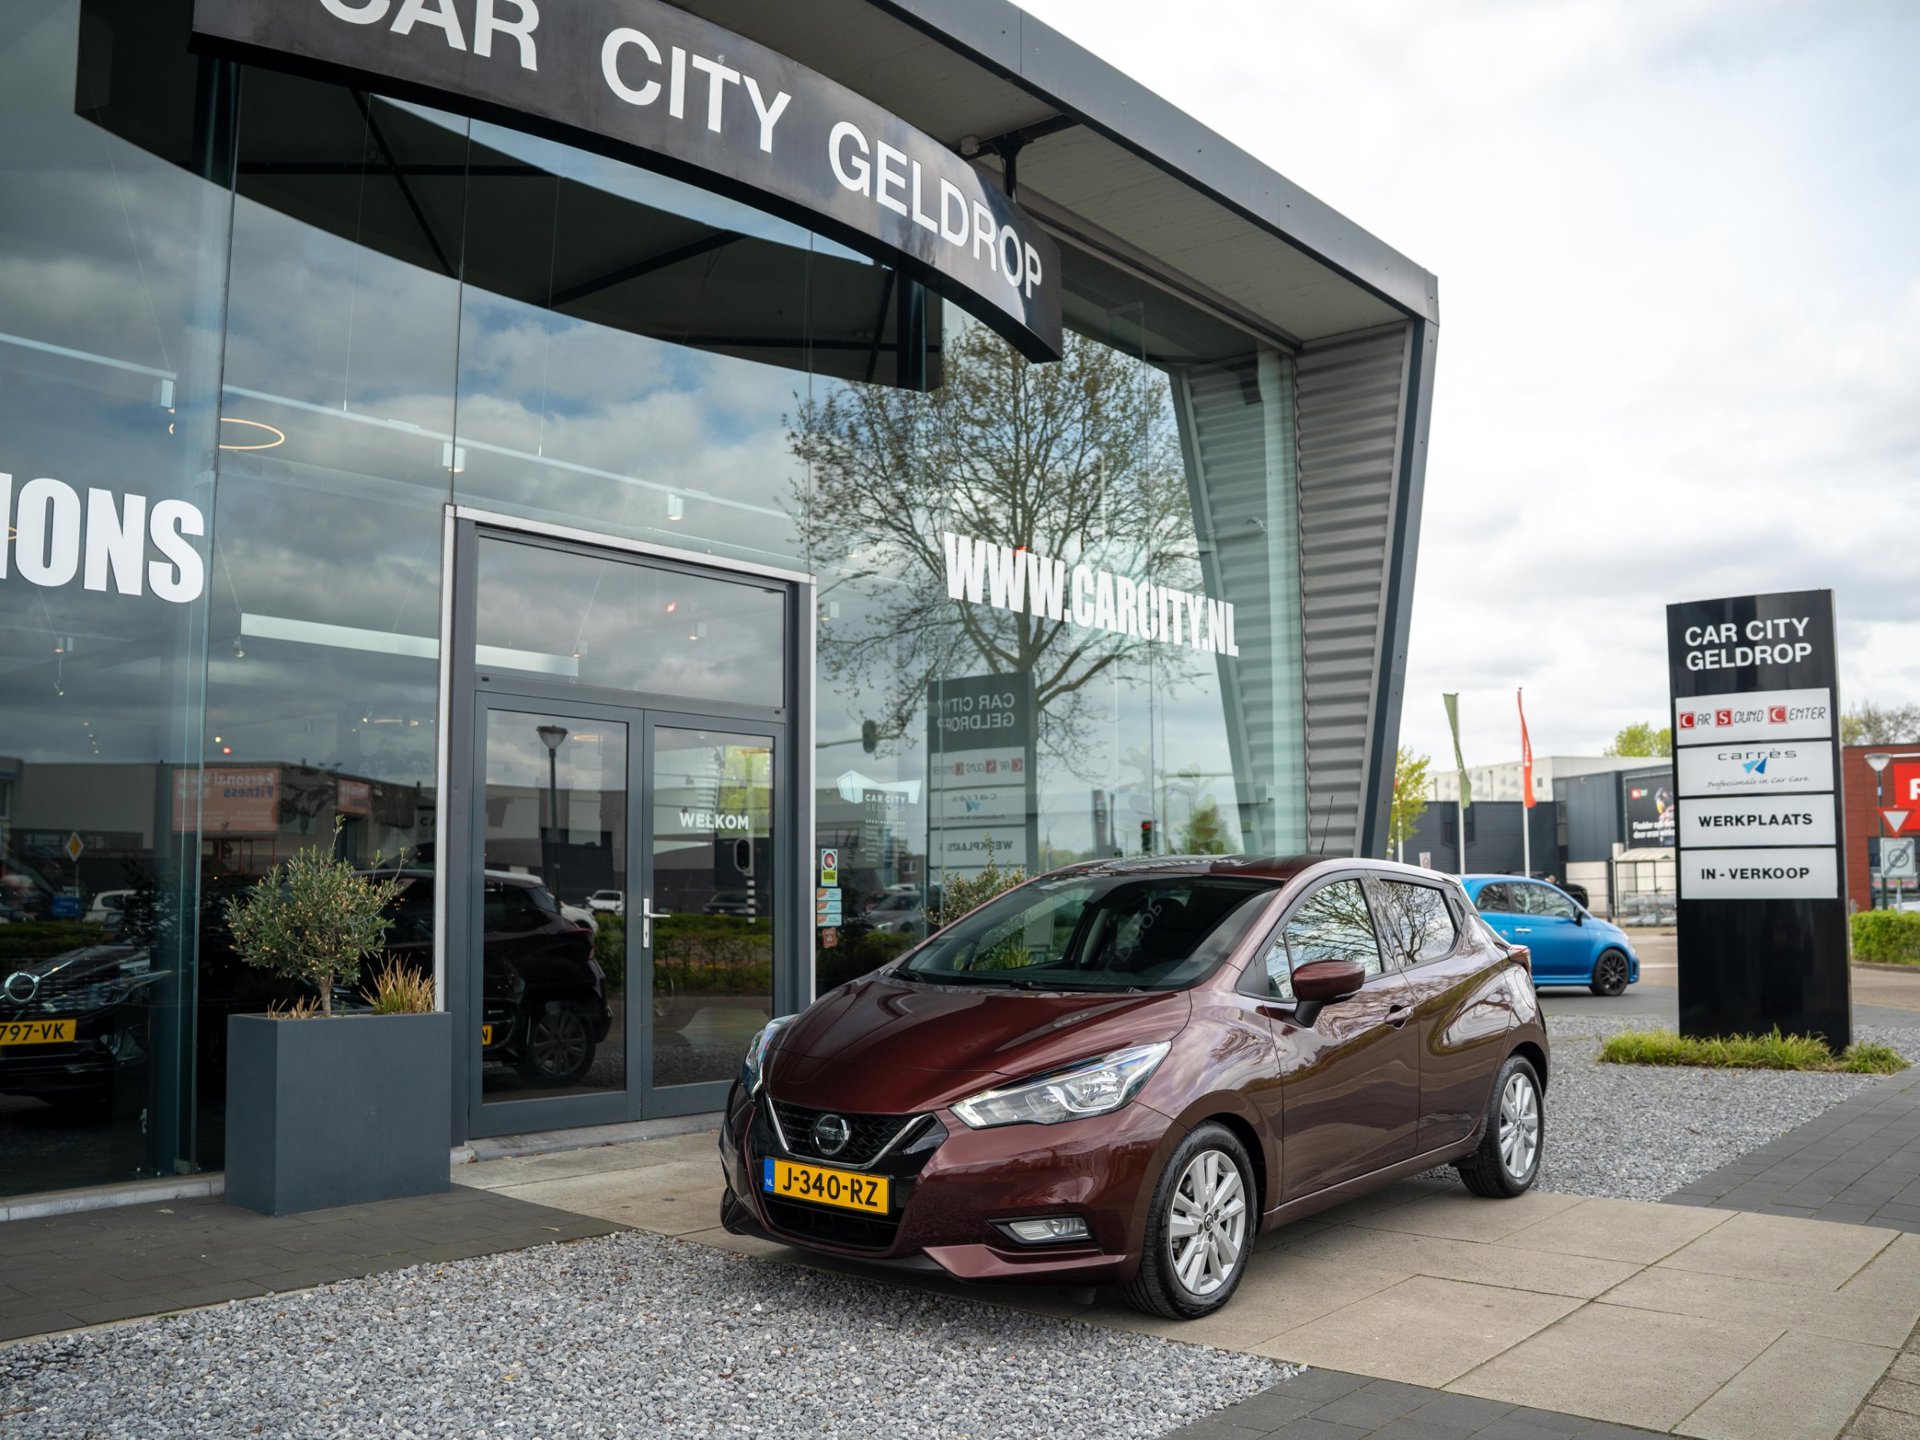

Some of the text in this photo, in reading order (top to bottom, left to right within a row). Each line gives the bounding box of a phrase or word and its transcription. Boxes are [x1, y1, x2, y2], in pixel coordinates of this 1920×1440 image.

[320, 0, 1043, 299] AR CITY GELDROP
[944, 531, 1239, 657] WWW.CARCITY.NL
[1685, 617, 1810, 647] CAR CITY
[1686, 643, 1812, 671] GELDROP
[1679, 704, 1826, 730] CAR SOUND CENTER
[679, 812, 749, 830] WELKOM
[1699, 813, 1813, 828] WERKPLAATS
[783, 1167, 878, 1207] J-340-RZ
